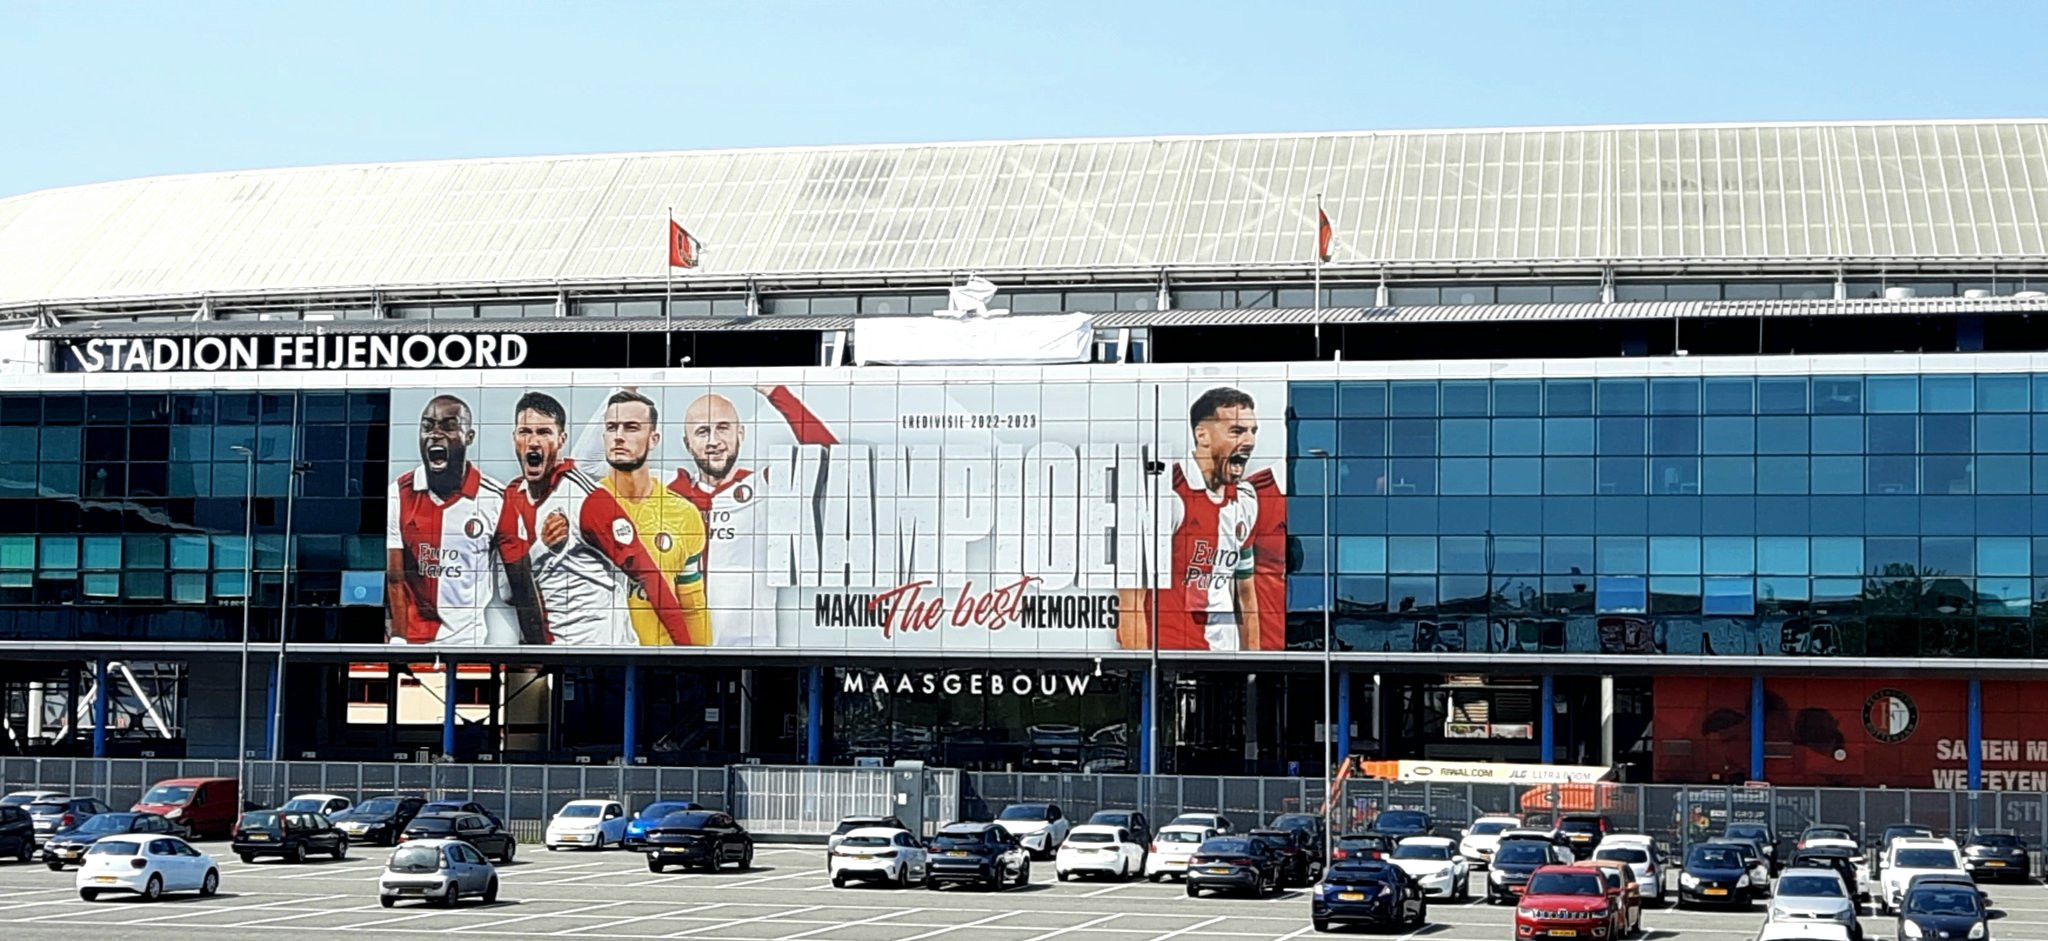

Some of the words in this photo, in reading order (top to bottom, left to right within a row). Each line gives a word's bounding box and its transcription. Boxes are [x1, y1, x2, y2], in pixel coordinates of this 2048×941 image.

[86, 337, 258, 371] STADION
[273, 333, 528, 368] FEIJENOORD
[902, 415, 963, 429] EREDIVISIE
[971, 414, 1036, 428] 2022-2023
[767, 442, 1173, 589] KAMPIOEN
[710, 527, 736, 540] rcs
[418, 543, 459, 561] Euro
[1191, 540, 1239, 567] Euro
[417, 561, 462, 578] Parcs
[1184, 566, 1230, 590] Parc
[815, 593, 890, 627] MAKING
[867, 580, 945, 640] The
[951, 575, 1044, 631] best
[1021, 594, 1120, 629] MEMORIES
[843, 673, 1090, 695] MAASGEBOUW
[1932, 769, 1968, 789] WE
